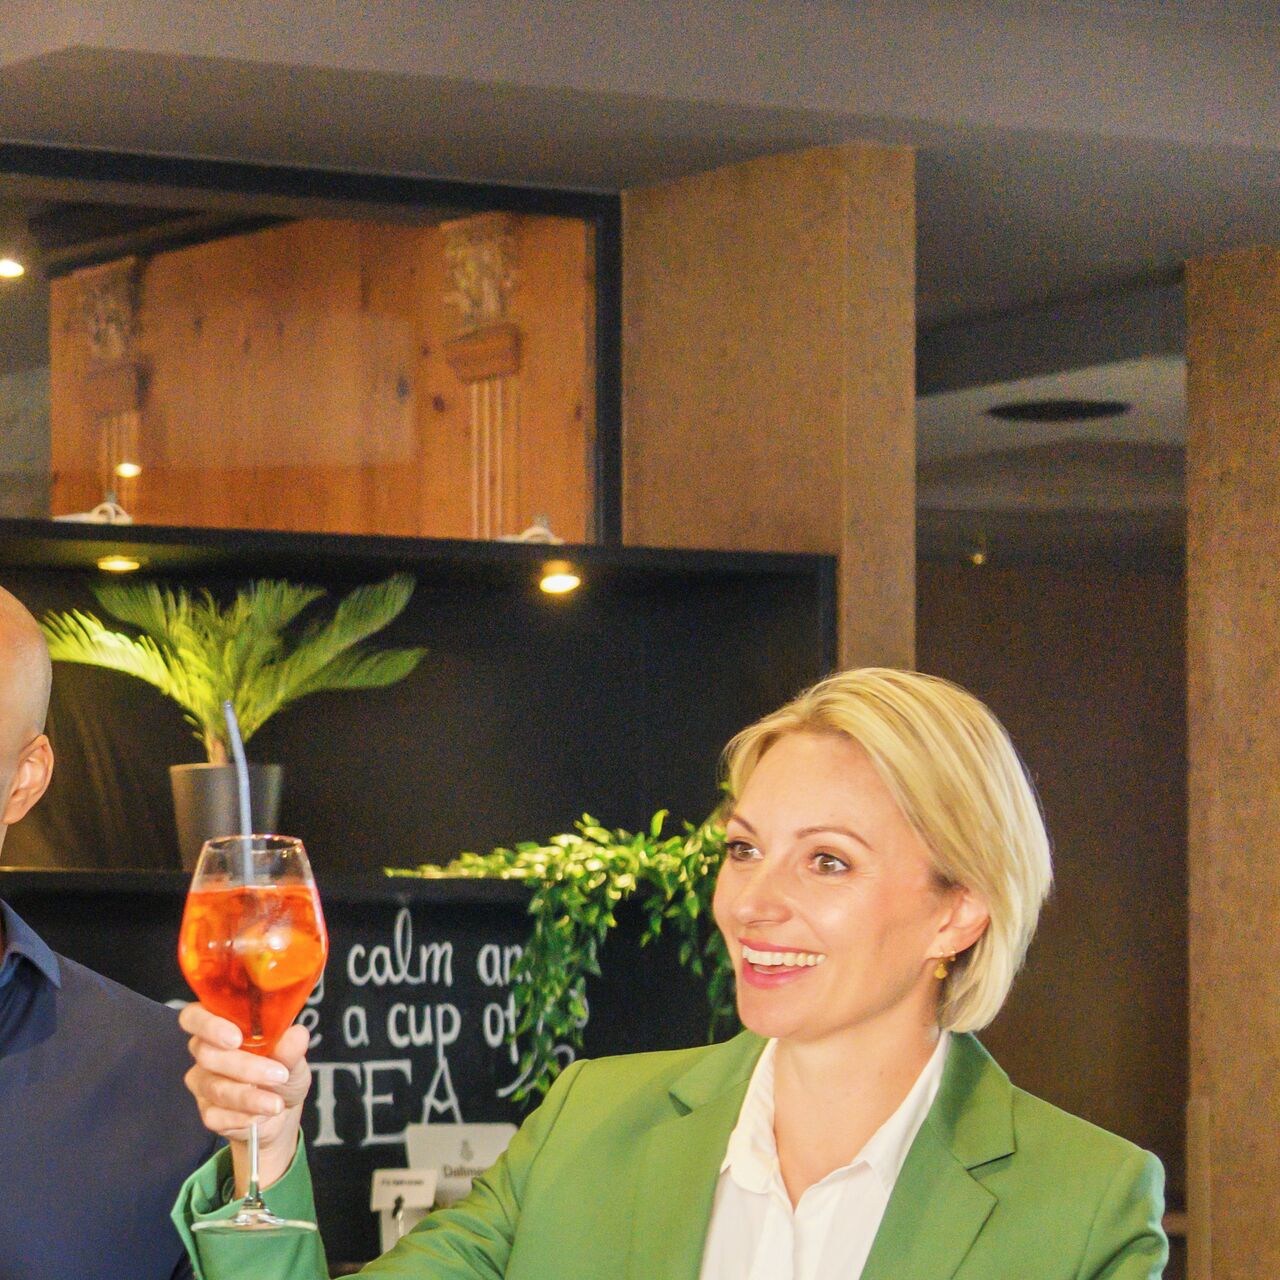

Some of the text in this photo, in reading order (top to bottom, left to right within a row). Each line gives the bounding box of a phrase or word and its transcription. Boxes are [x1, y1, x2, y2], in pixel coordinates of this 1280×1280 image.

[347, 908, 532, 987] calm an
[343, 1005, 369, 1048] a
[387, 1003, 462, 1064] cup
[308, 1055, 464, 1147] TEA
